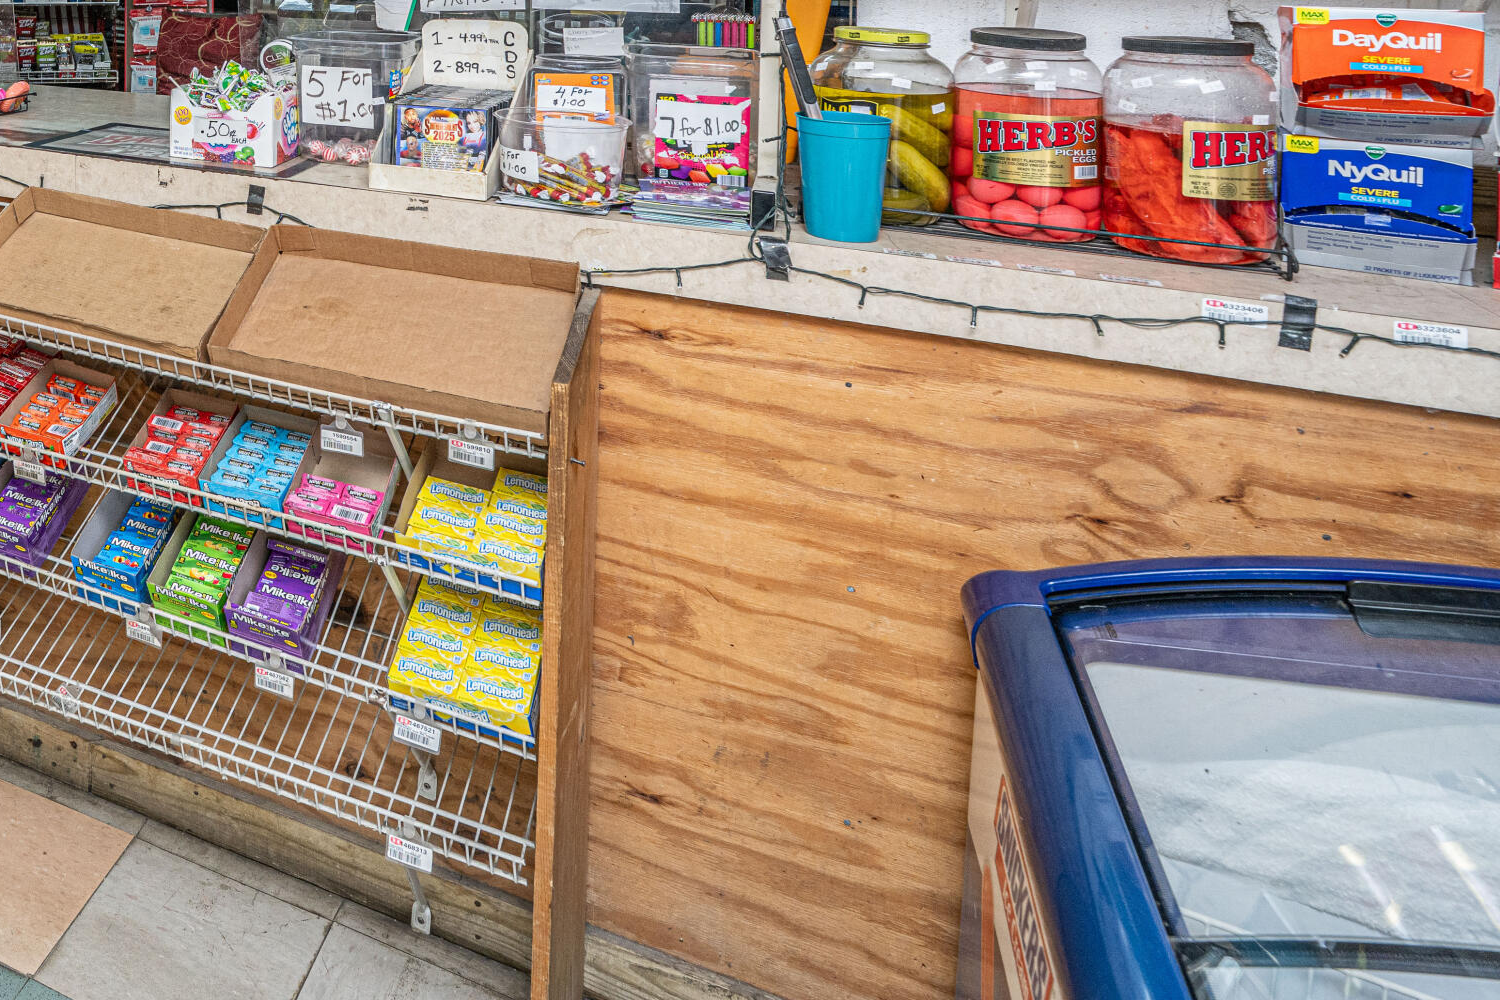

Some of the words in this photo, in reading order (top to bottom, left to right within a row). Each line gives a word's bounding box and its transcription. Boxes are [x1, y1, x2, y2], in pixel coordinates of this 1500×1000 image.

[1300, 10, 1325, 19] MAX
[1332, 29, 1443, 53] DayQuil
[433, 60, 444, 72] 2
[1362, 55, 1411, 65] SEVERE
[306, 70, 327, 97] 5
[556, 87, 566, 98] 4
[553, 99, 586, 107] $1.00
[315, 99, 374, 123] $1.00
[660, 117, 674, 137] 7
[680, 118, 701, 137] for
[704, 117, 739, 136] $1.00
[978, 119, 1097, 153] HERB'S
[1327, 159, 1424, 187] NyQuil
[1351, 186, 1399, 198] SEVERE
[5, 490, 32, 504] Mike
